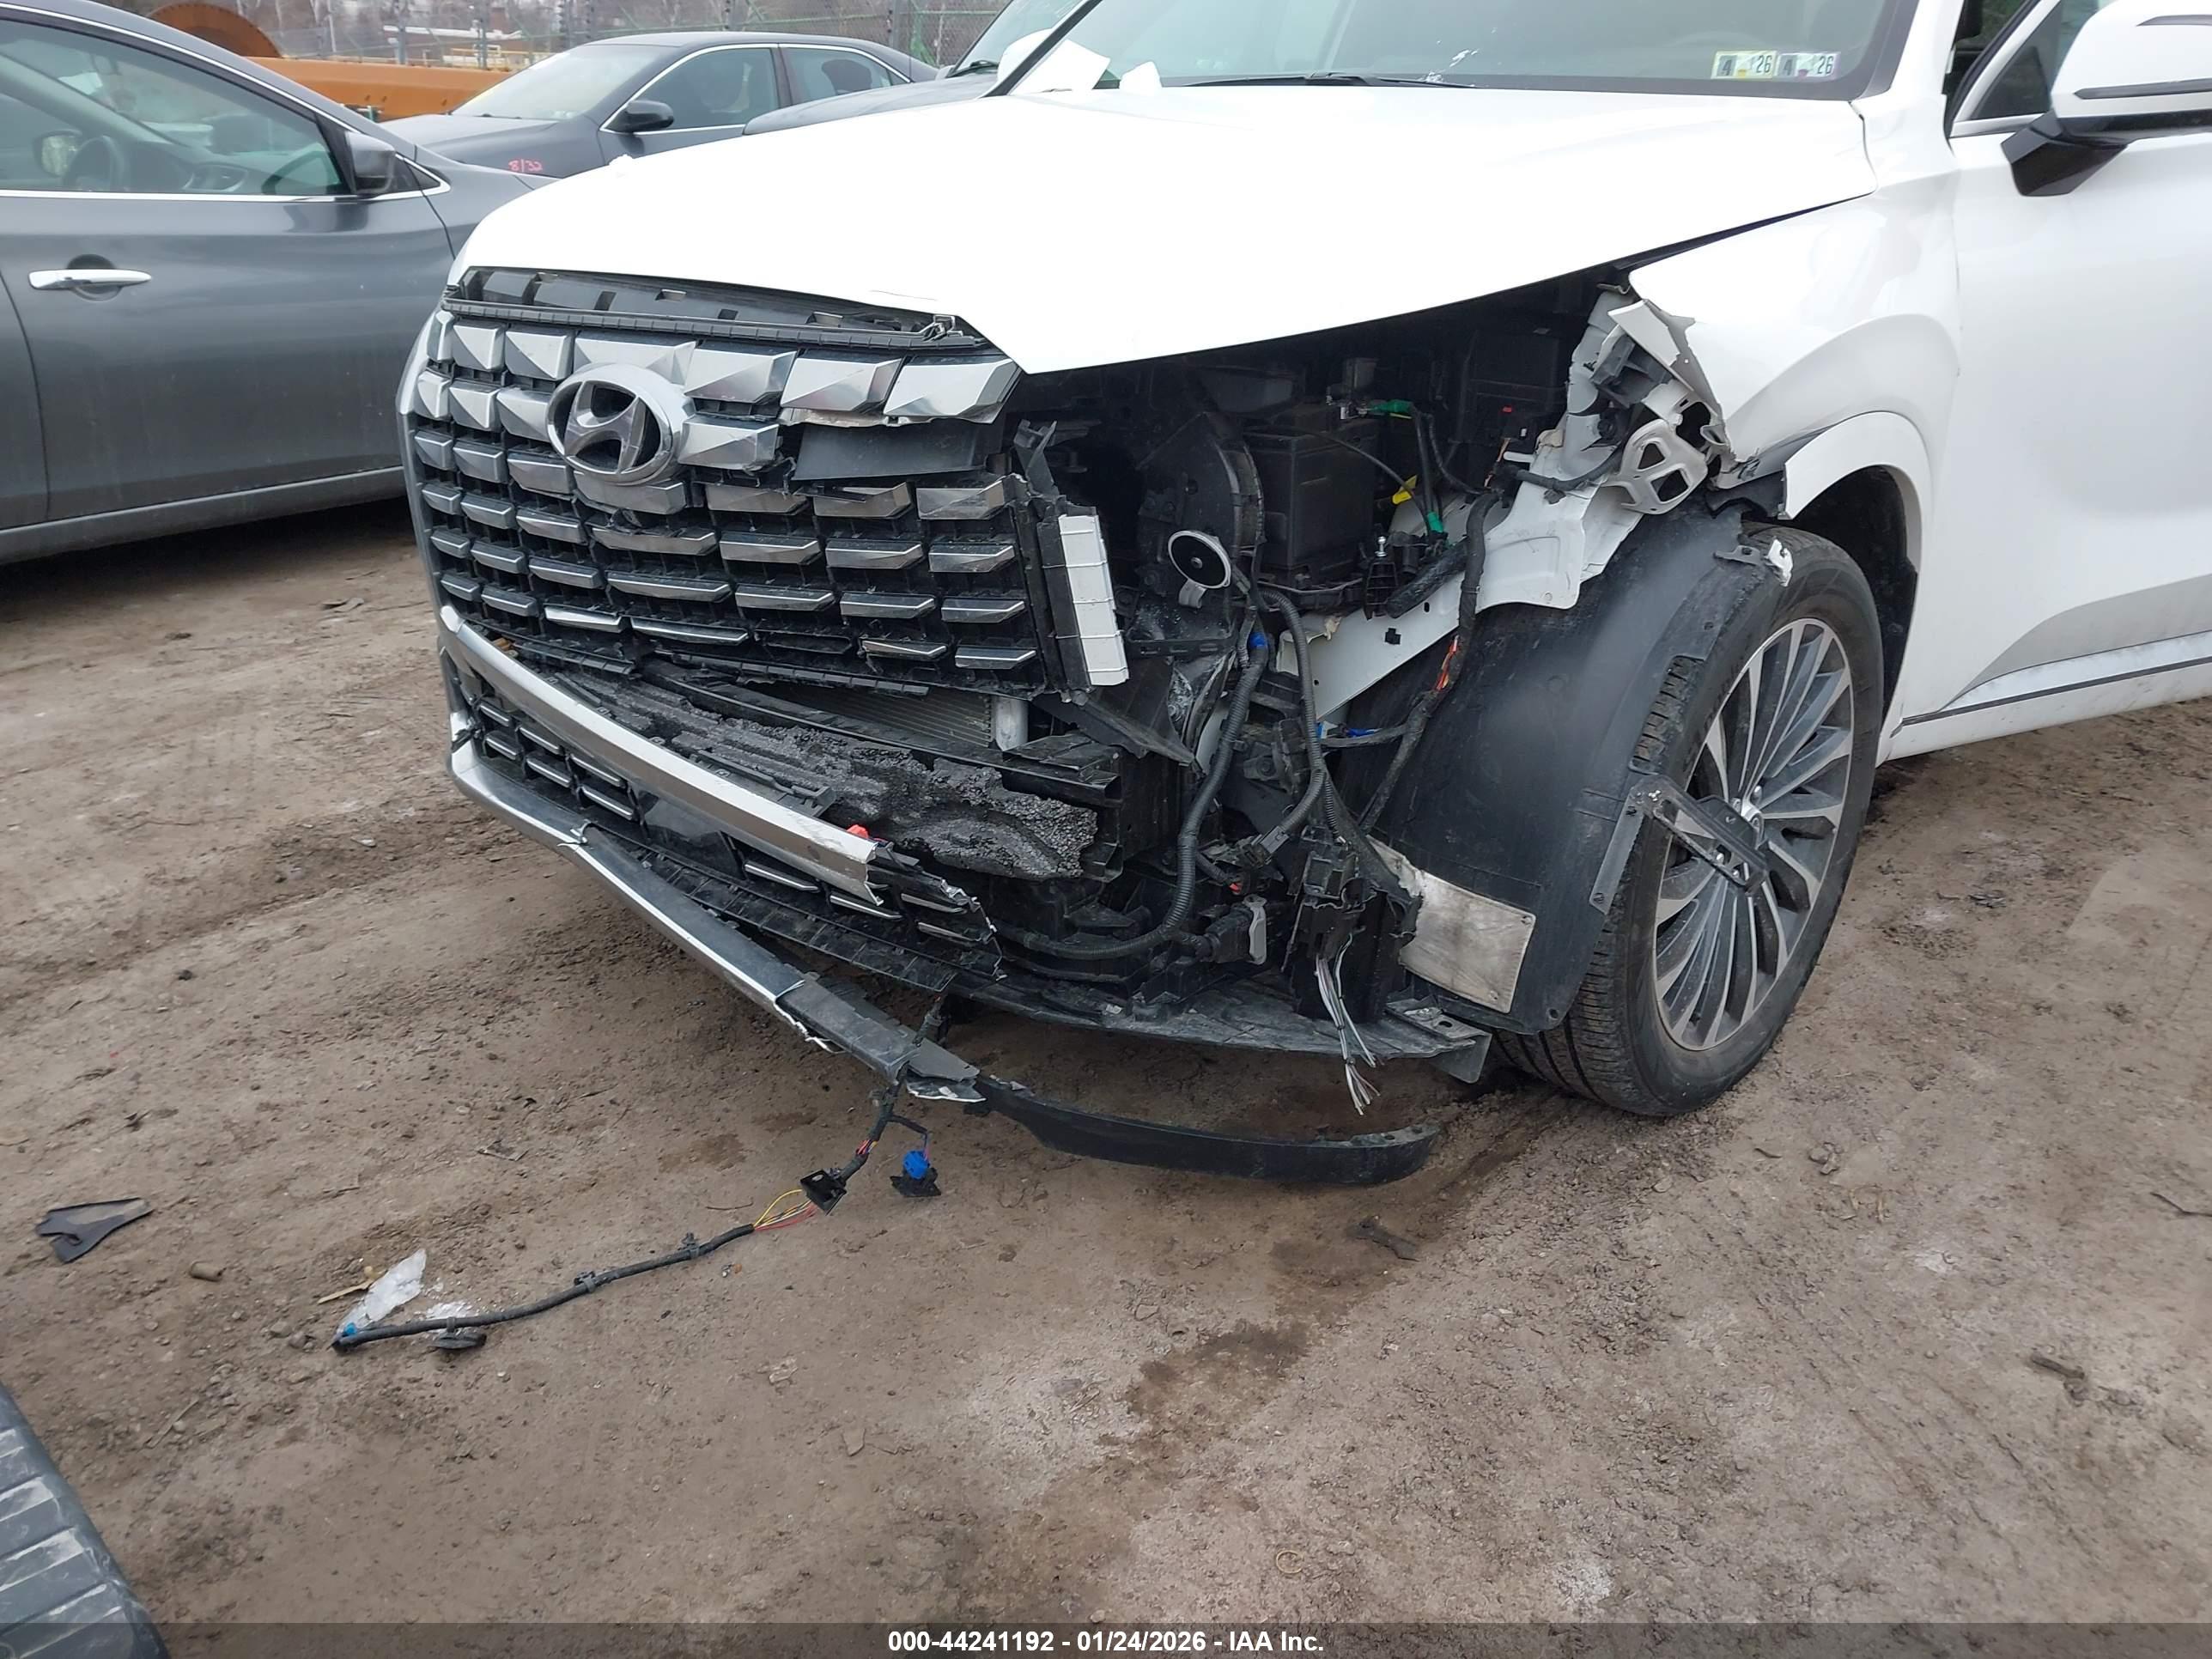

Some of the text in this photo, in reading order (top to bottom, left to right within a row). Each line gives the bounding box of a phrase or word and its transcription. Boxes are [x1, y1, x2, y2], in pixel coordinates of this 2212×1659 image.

[1722, 55, 1773, 76] 4 26
[1783, 55, 1834, 76] 4 26
